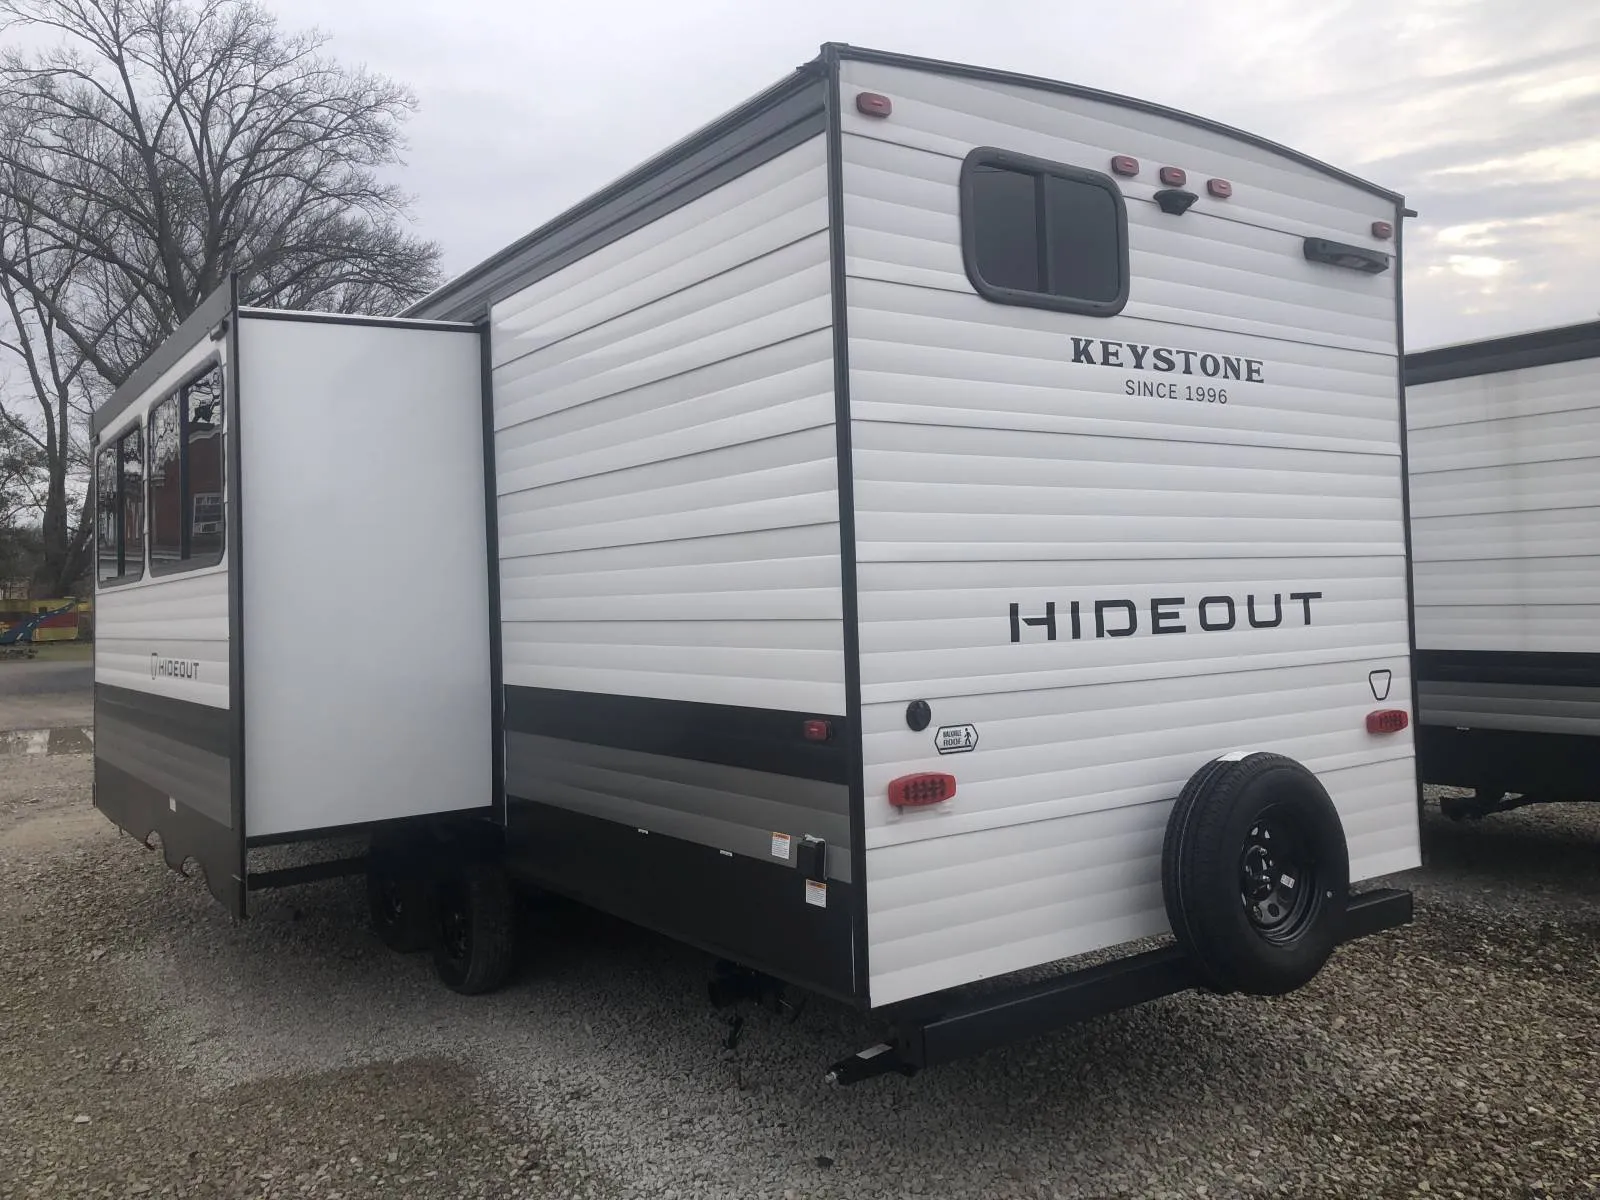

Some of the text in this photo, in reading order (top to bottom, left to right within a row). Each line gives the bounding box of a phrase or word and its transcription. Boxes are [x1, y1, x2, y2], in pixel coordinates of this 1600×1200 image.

[1070, 337, 1265, 384] KEYSTONE
[1125, 379, 1228, 405] SINCE 1996
[1009, 591, 1323, 643] HIDEOUT
[159, 660, 200, 680] HIDEOUT
